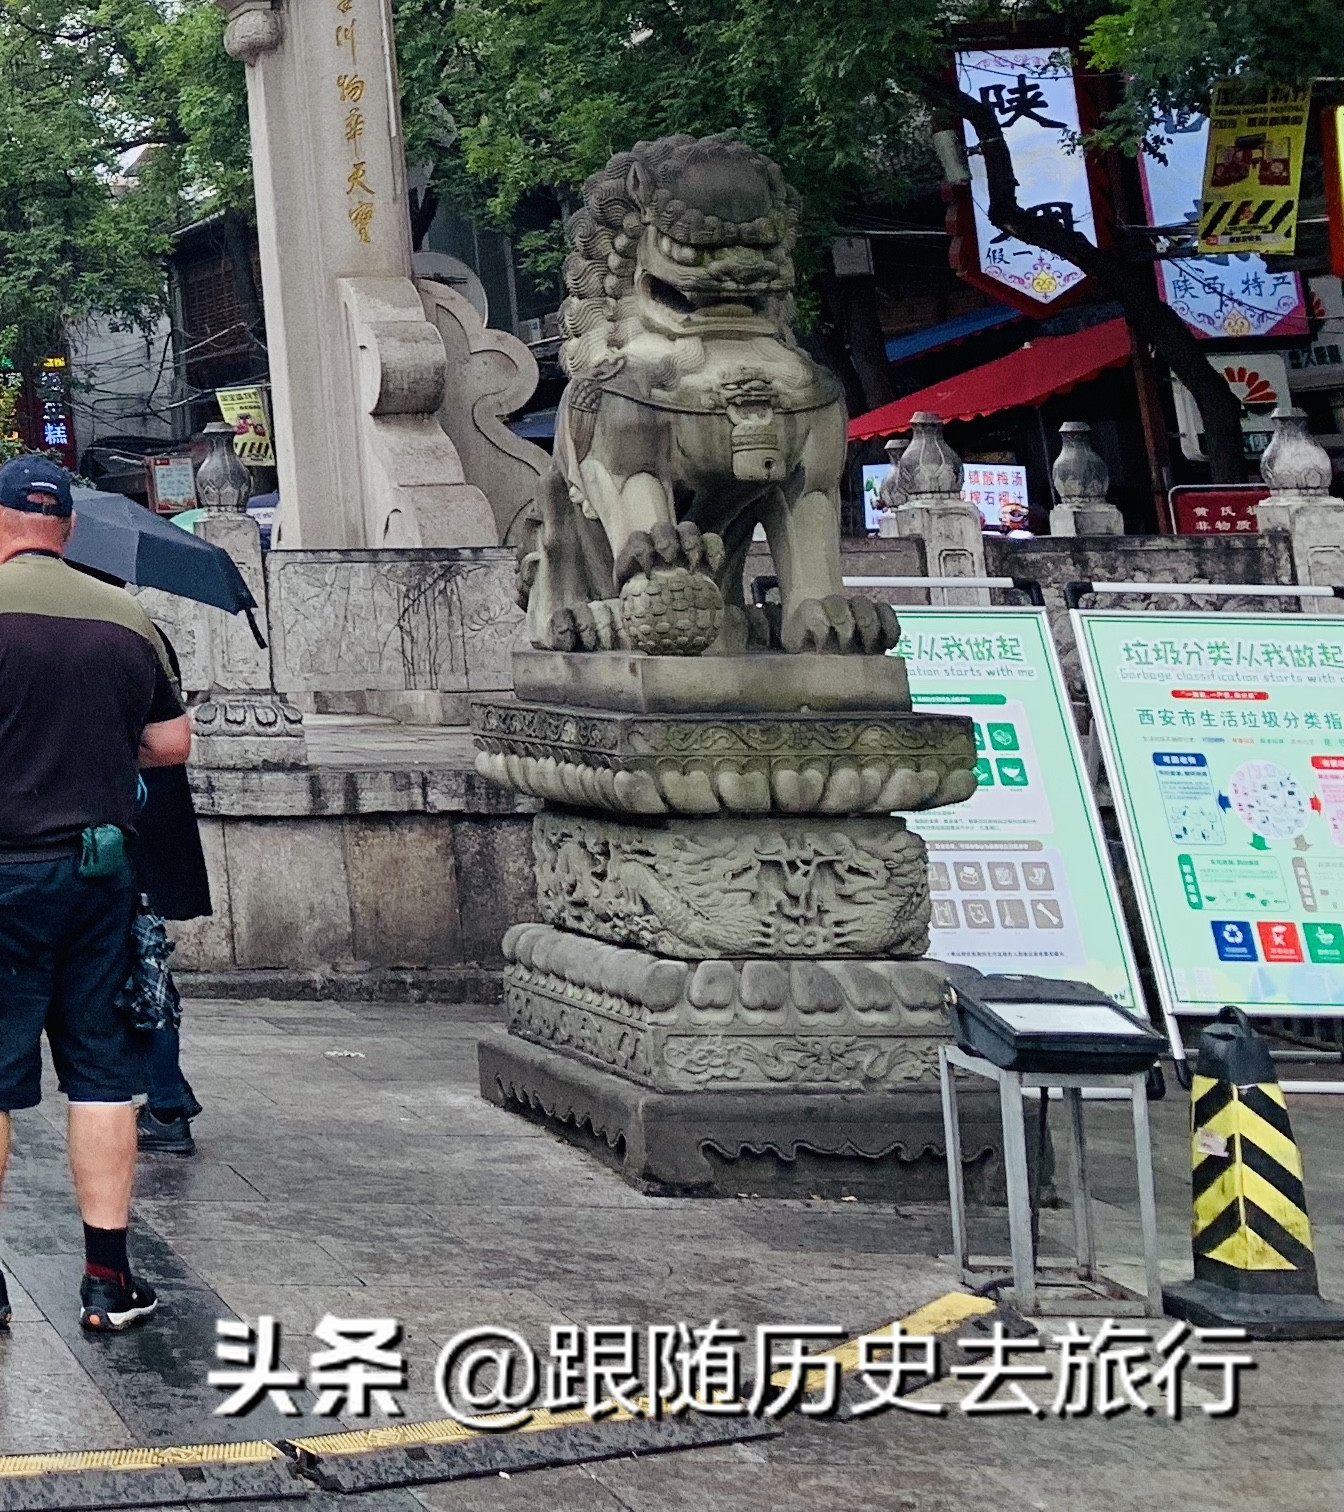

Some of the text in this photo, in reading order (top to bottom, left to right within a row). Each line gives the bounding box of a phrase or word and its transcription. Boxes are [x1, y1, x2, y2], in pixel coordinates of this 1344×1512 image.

[1123, 640, 1344, 669] 垃圾分类从我做起
[943, 666, 982, 677] starts
[986, 666, 1014, 677] with
[1017, 669, 1035, 677] me
[1177, 669, 1259, 682] classification
[1263, 671, 1303, 683] starts
[1307, 673, 1335, 683] with
[1136, 708, 1343, 731] 西安市生活垃圾分类指
